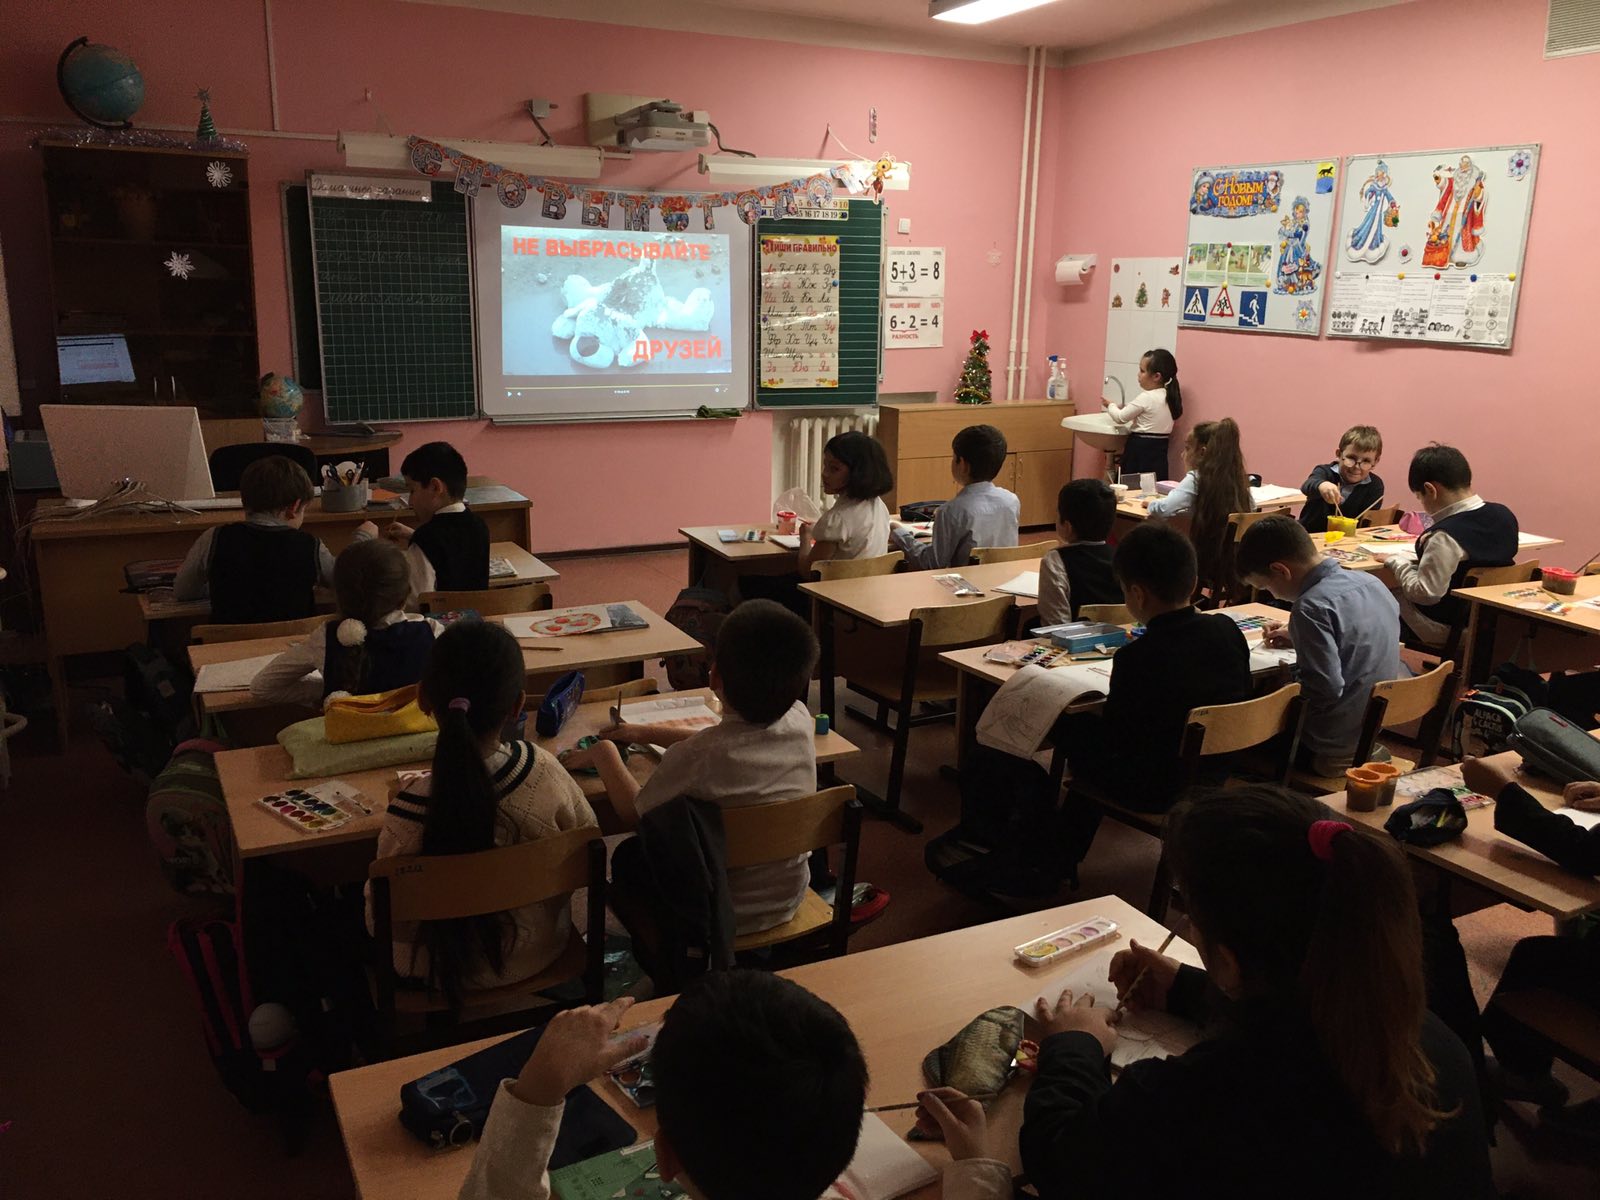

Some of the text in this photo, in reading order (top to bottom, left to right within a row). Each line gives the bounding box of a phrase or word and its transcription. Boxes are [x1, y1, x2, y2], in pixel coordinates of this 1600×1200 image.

[513, 237, 712, 261] НЕ ВЫБРАСЫВАЙТЕ
[933, 261, 940, 280] 8
[890, 315, 897, 329] 6
[909, 315, 916, 328] 2
[932, 315, 939, 328] 4
[633, 336, 722, 362] ДРУЗЕЙ
